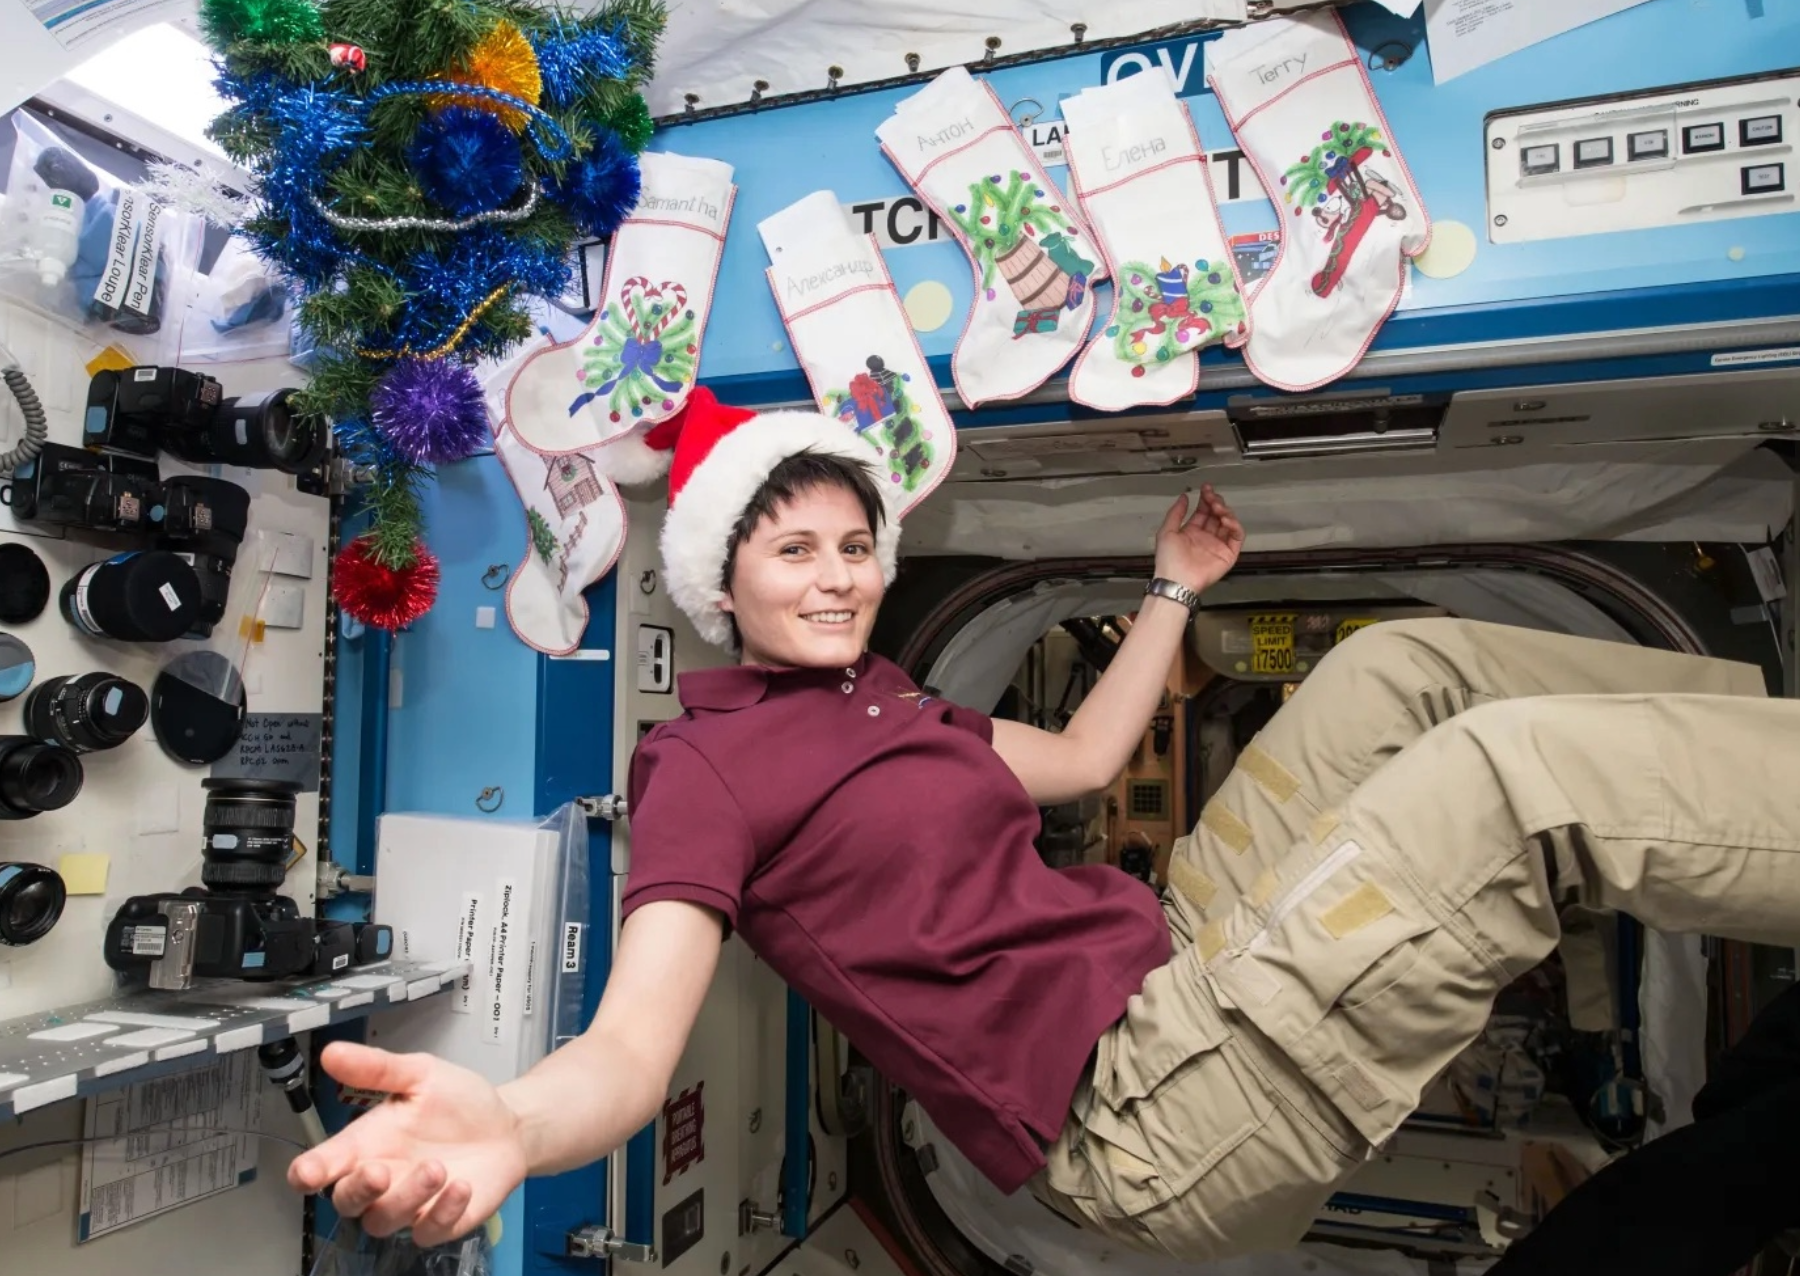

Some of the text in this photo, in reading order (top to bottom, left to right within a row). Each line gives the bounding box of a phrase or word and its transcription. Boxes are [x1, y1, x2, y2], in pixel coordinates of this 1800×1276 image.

[1106, 40, 1214, 93] OV
[1249, 52, 1308, 85] Terry
[1032, 124, 1069, 147] LA
[1101, 137, 1166, 172] Елена
[638, 185, 718, 221] Samantha
[101, 258, 126, 302] Loupe
[130, 281, 148, 309] Pen
[1252, 625, 1291, 635] SPEED
[1257, 636, 1286, 646] LIMIT
[1256, 648, 1292, 670] 17500
[467, 899, 478, 930] Printer
[500, 921, 509, 934] A4
[464, 930, 475, 958] Paper
[498, 934, 507, 966] Printer
[565, 926, 579, 969] Ream 3
[495, 967, 504, 993] Paper
